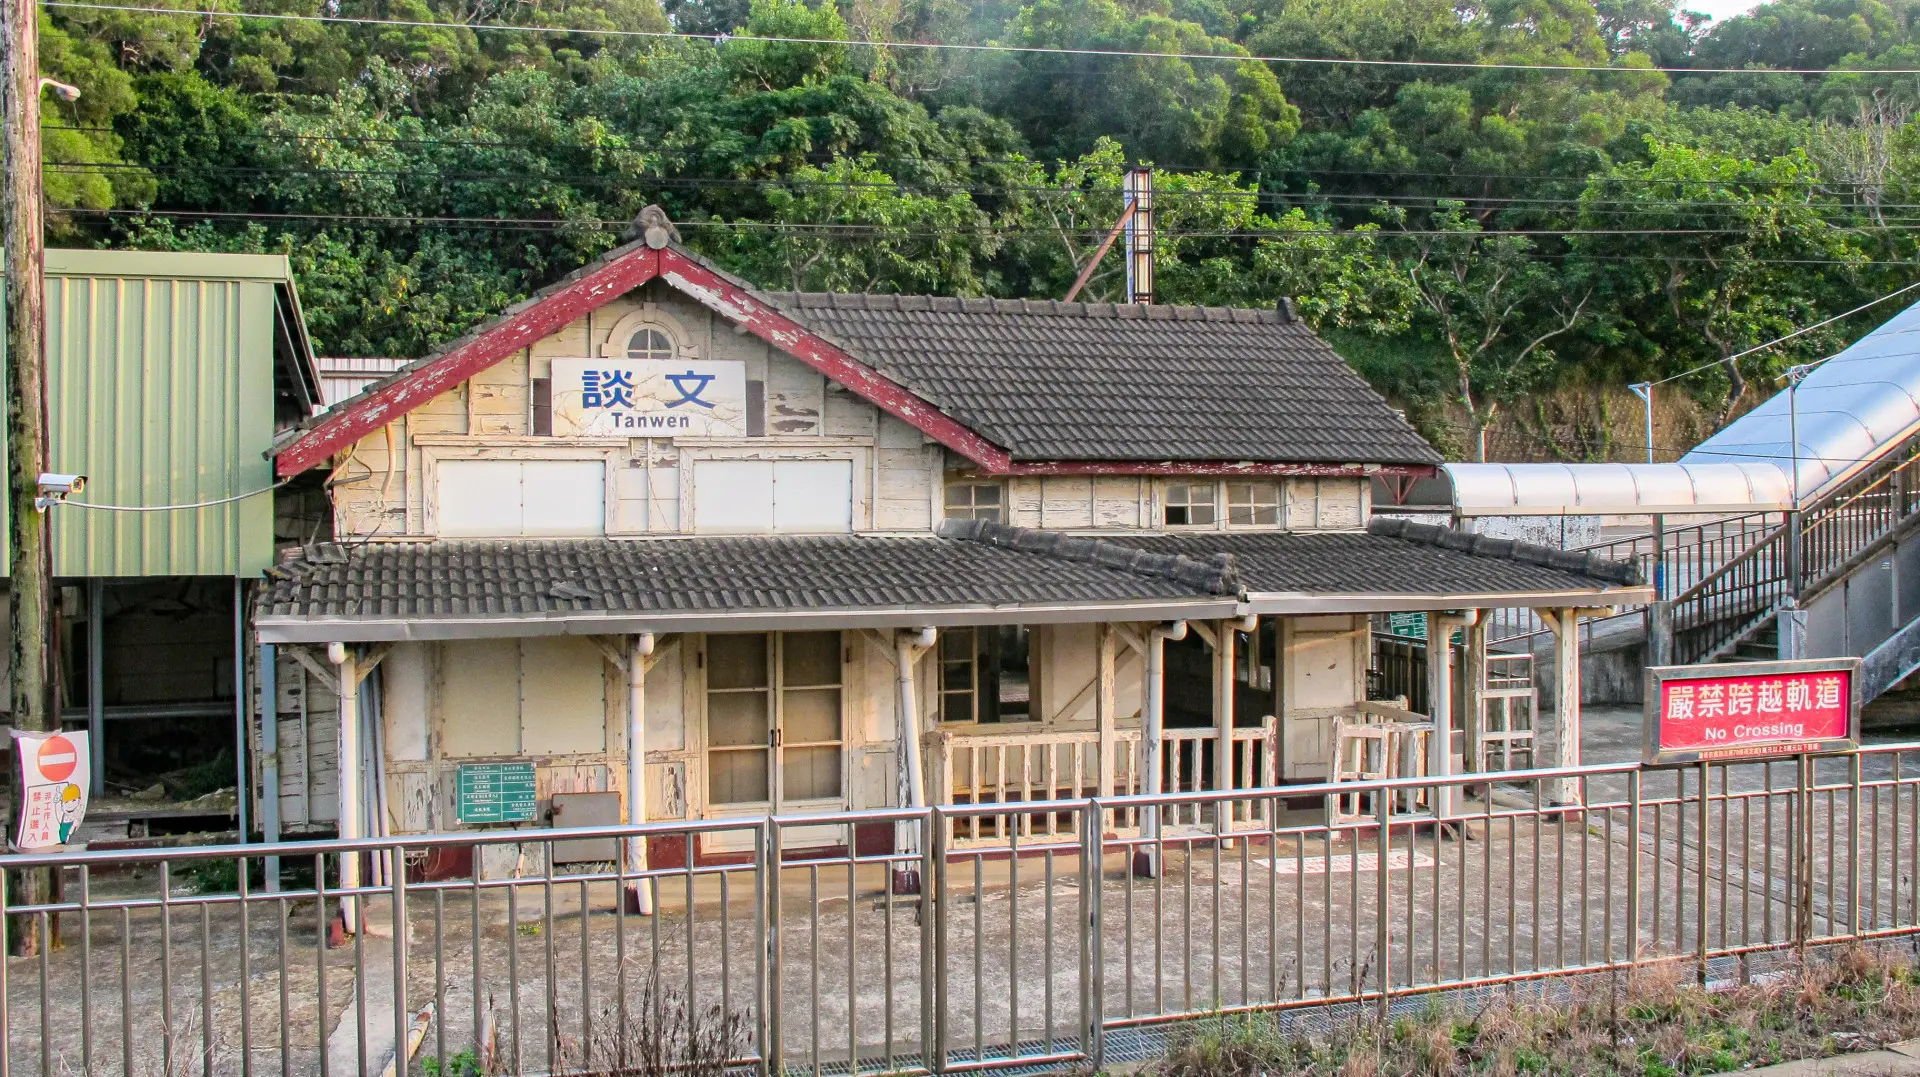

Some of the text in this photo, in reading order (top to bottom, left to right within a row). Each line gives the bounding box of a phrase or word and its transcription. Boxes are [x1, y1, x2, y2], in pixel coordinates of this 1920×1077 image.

[582, 370, 716, 408] 談文
[611, 412, 690, 428] Tanwen
[1667, 678, 1841, 719] 嚴禁跨越軌道
[1705, 722, 1804, 740] No Crossing
[28, 792, 41, 842] 禁止進入
[42, 792, 52, 840] 非工作人員
